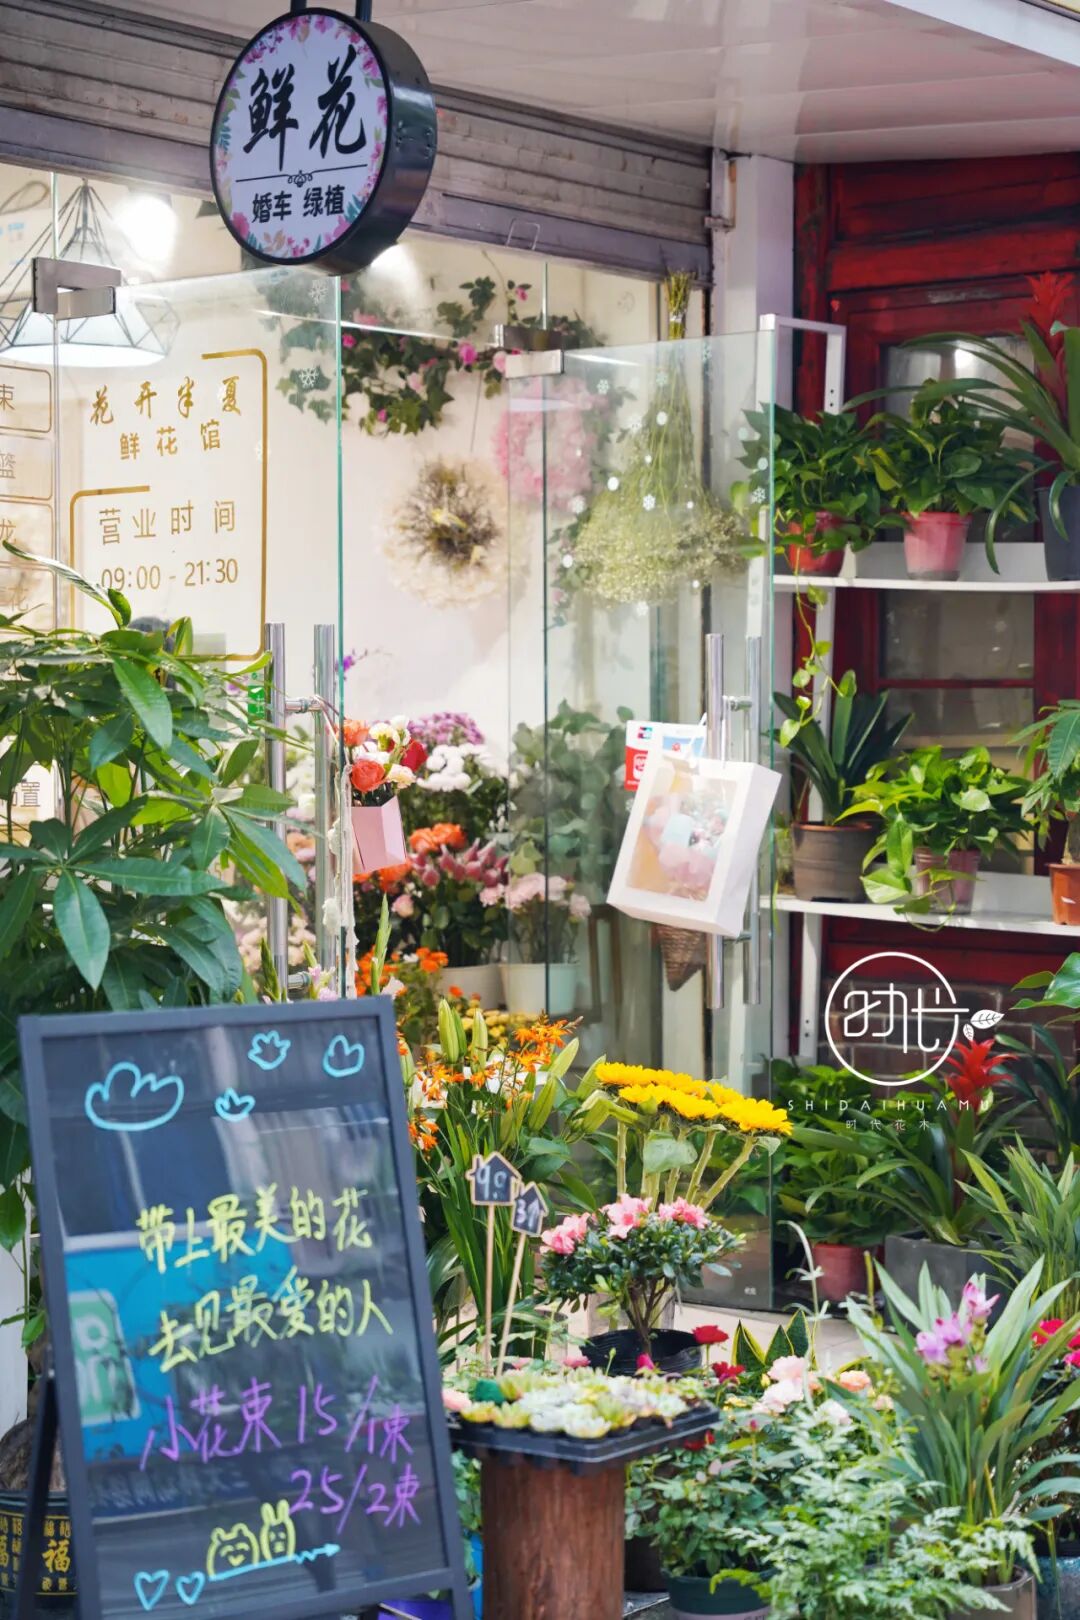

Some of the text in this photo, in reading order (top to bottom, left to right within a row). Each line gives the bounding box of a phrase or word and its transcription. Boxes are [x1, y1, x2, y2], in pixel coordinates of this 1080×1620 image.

[243, 44, 367, 171] 鲜花
[251, 185, 345, 223] 婚车 绿植
[89, 376, 241, 426] 花开半夏
[119, 419, 220, 460] 鲜花馆
[99, 500, 236, 545] 营业时间
[136, 1183, 373, 1273] 带上最美的花
[149, 1265, 393, 1373] 去见最爱的人
[42, 1539, 71, 1573] 福
